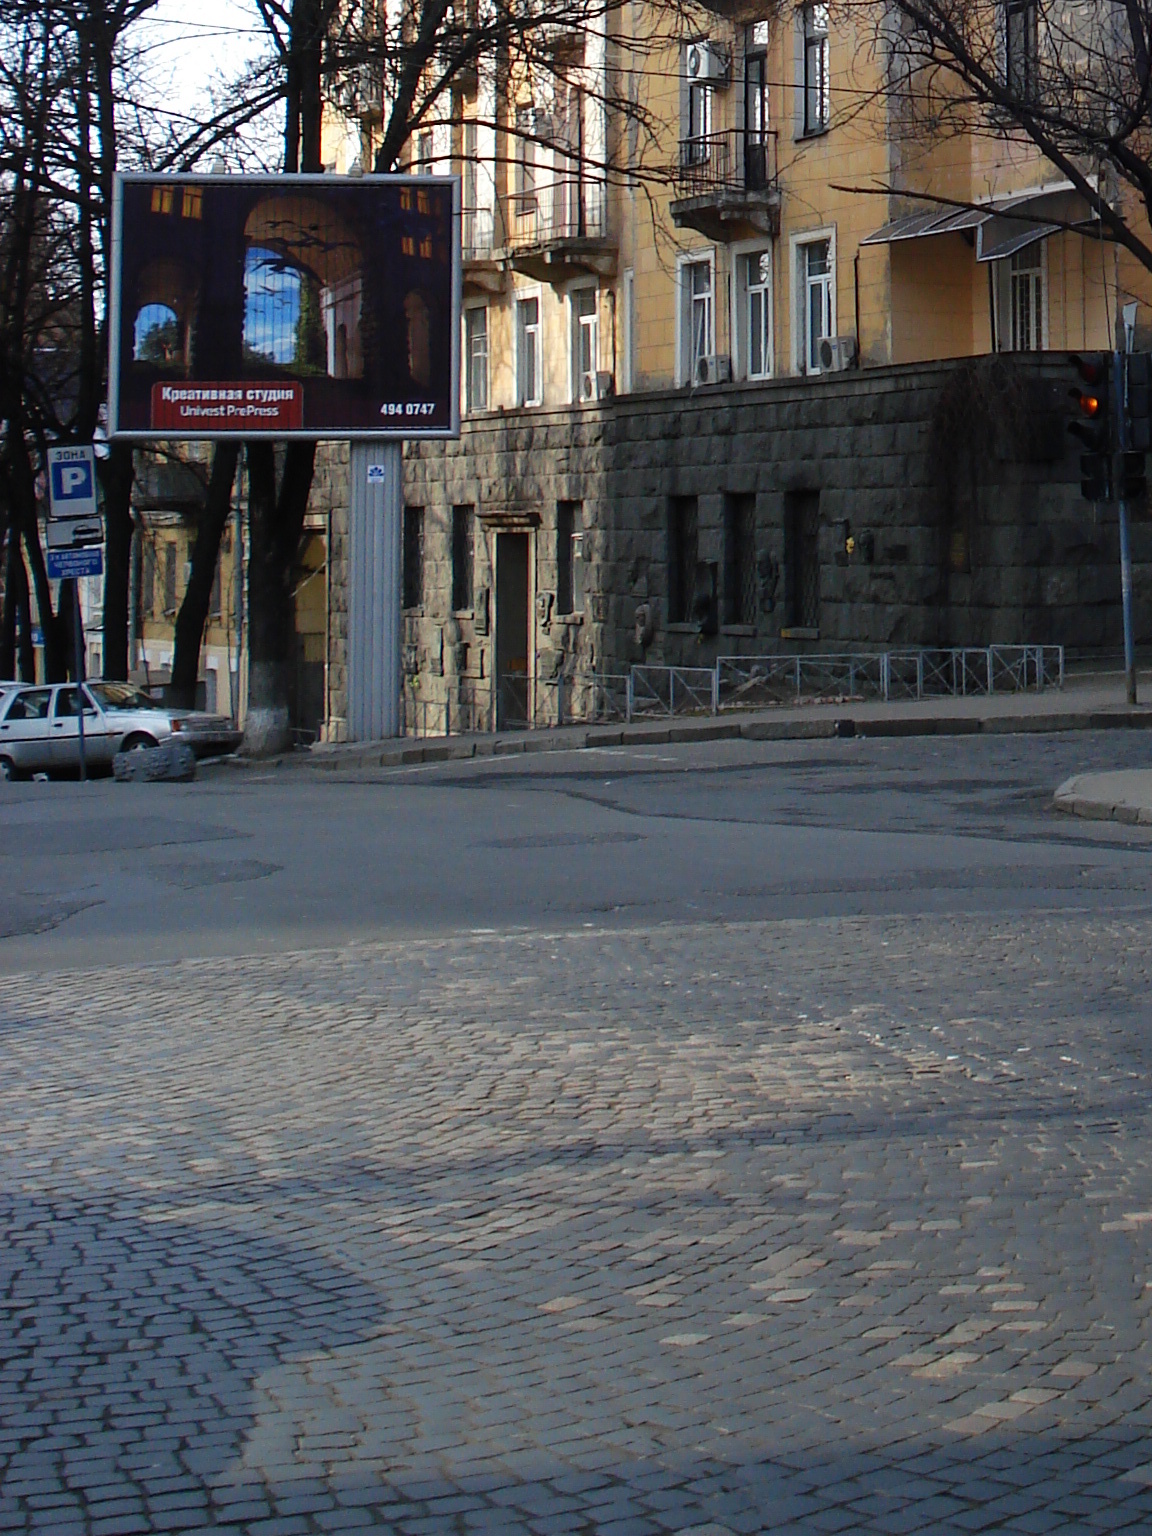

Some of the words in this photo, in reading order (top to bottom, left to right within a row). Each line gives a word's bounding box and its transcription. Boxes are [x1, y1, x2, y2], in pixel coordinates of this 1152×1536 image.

[162, 387, 243, 402] Креативная
[246, 389, 294, 402] студия
[180, 405, 225, 416] Univest
[227, 405, 279, 416] PrePress
[381, 403, 403, 415] 494
[406, 404, 435, 415] 0747
[56, 450, 85, 461] ЗОНА
